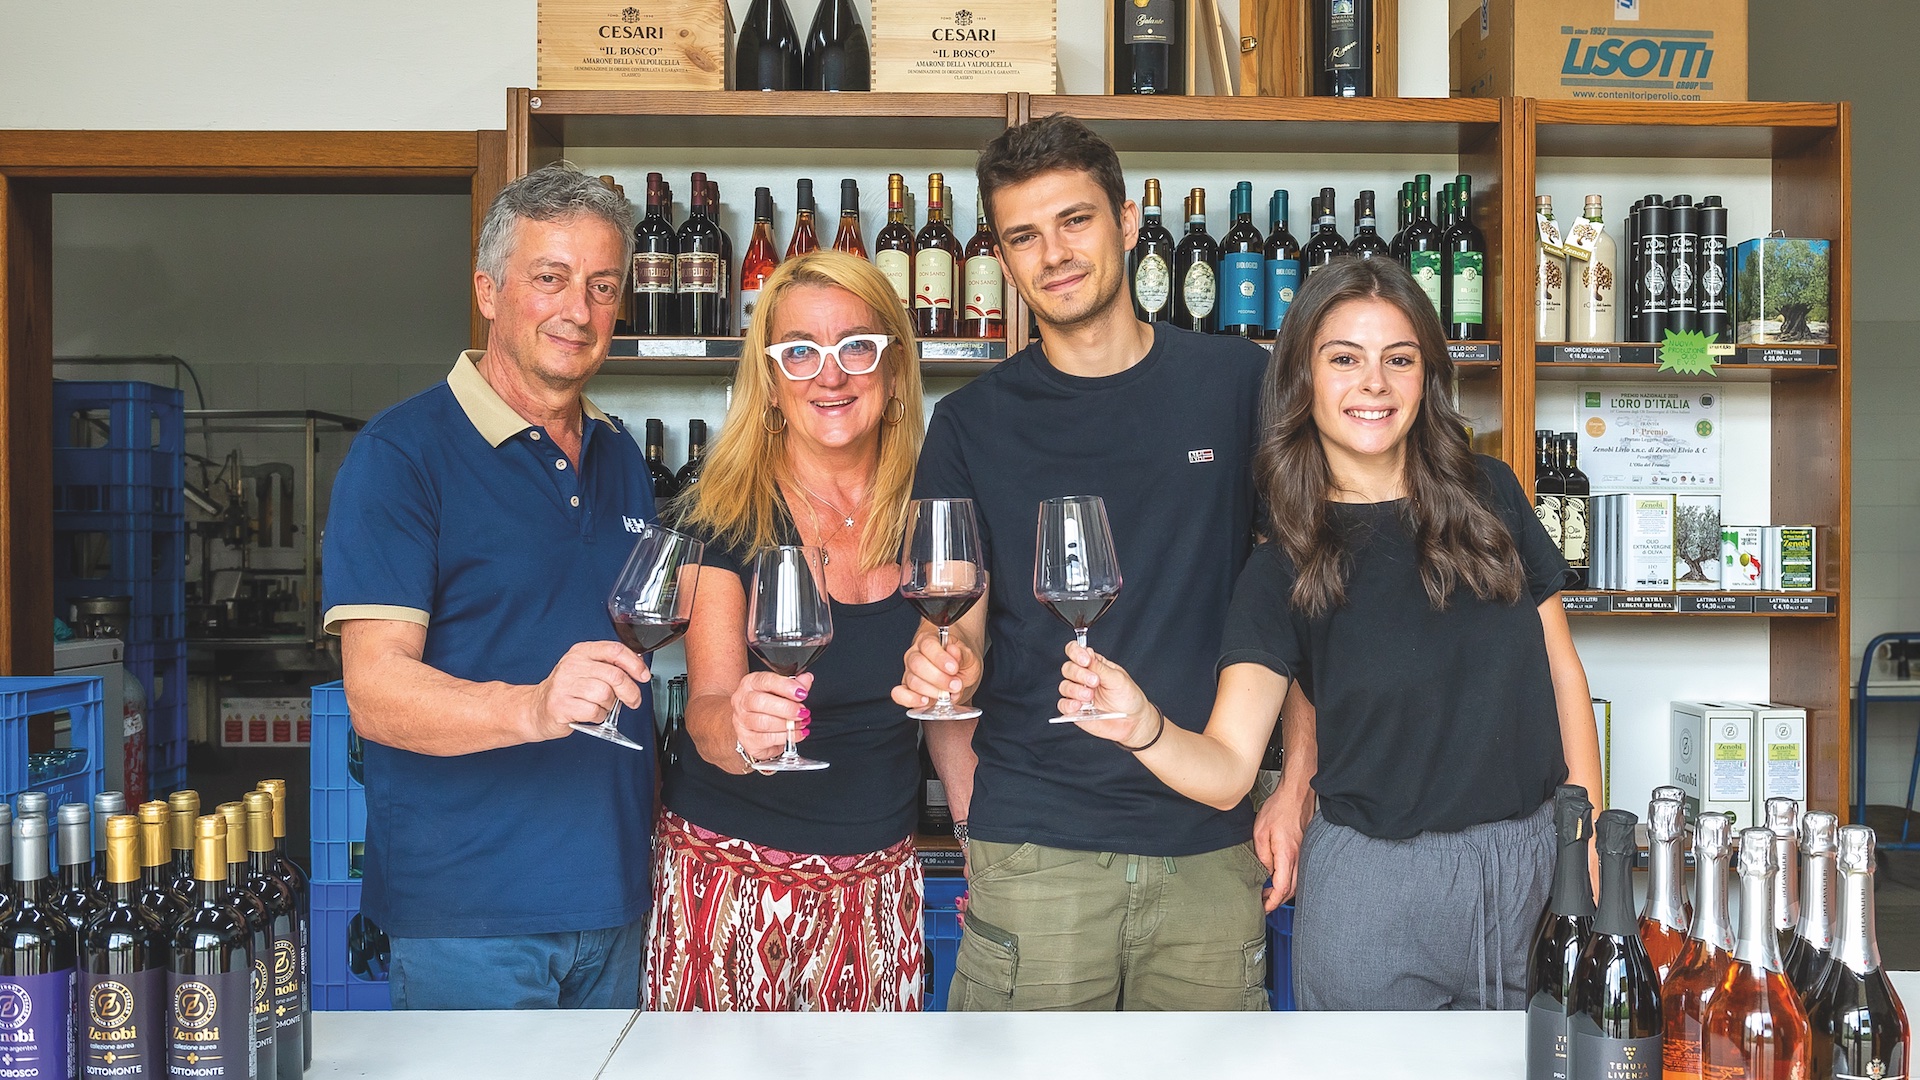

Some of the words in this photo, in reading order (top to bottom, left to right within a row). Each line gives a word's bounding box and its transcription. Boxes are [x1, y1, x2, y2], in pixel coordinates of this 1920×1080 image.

[599, 26, 663, 39] CESARI
[932, 28, 996, 41] CESARI
[1573, 90, 1700, 101] www.contenitoriperolio.com
[1564, 246, 1588, 258] Zenobi
[1675, 767, 1696, 786] Zenobi
[275, 980, 298, 996] nobi
[0, 1028, 35, 1042] nobi
[89, 1026, 137, 1040] Zenobi
[173, 1026, 220, 1041] Zenobi
[0, 1068, 39, 1077] OBOSCO
[87, 1065, 142, 1076] SOTTOMONTE
[171, 1066, 224, 1076] SOTTOMONTE
